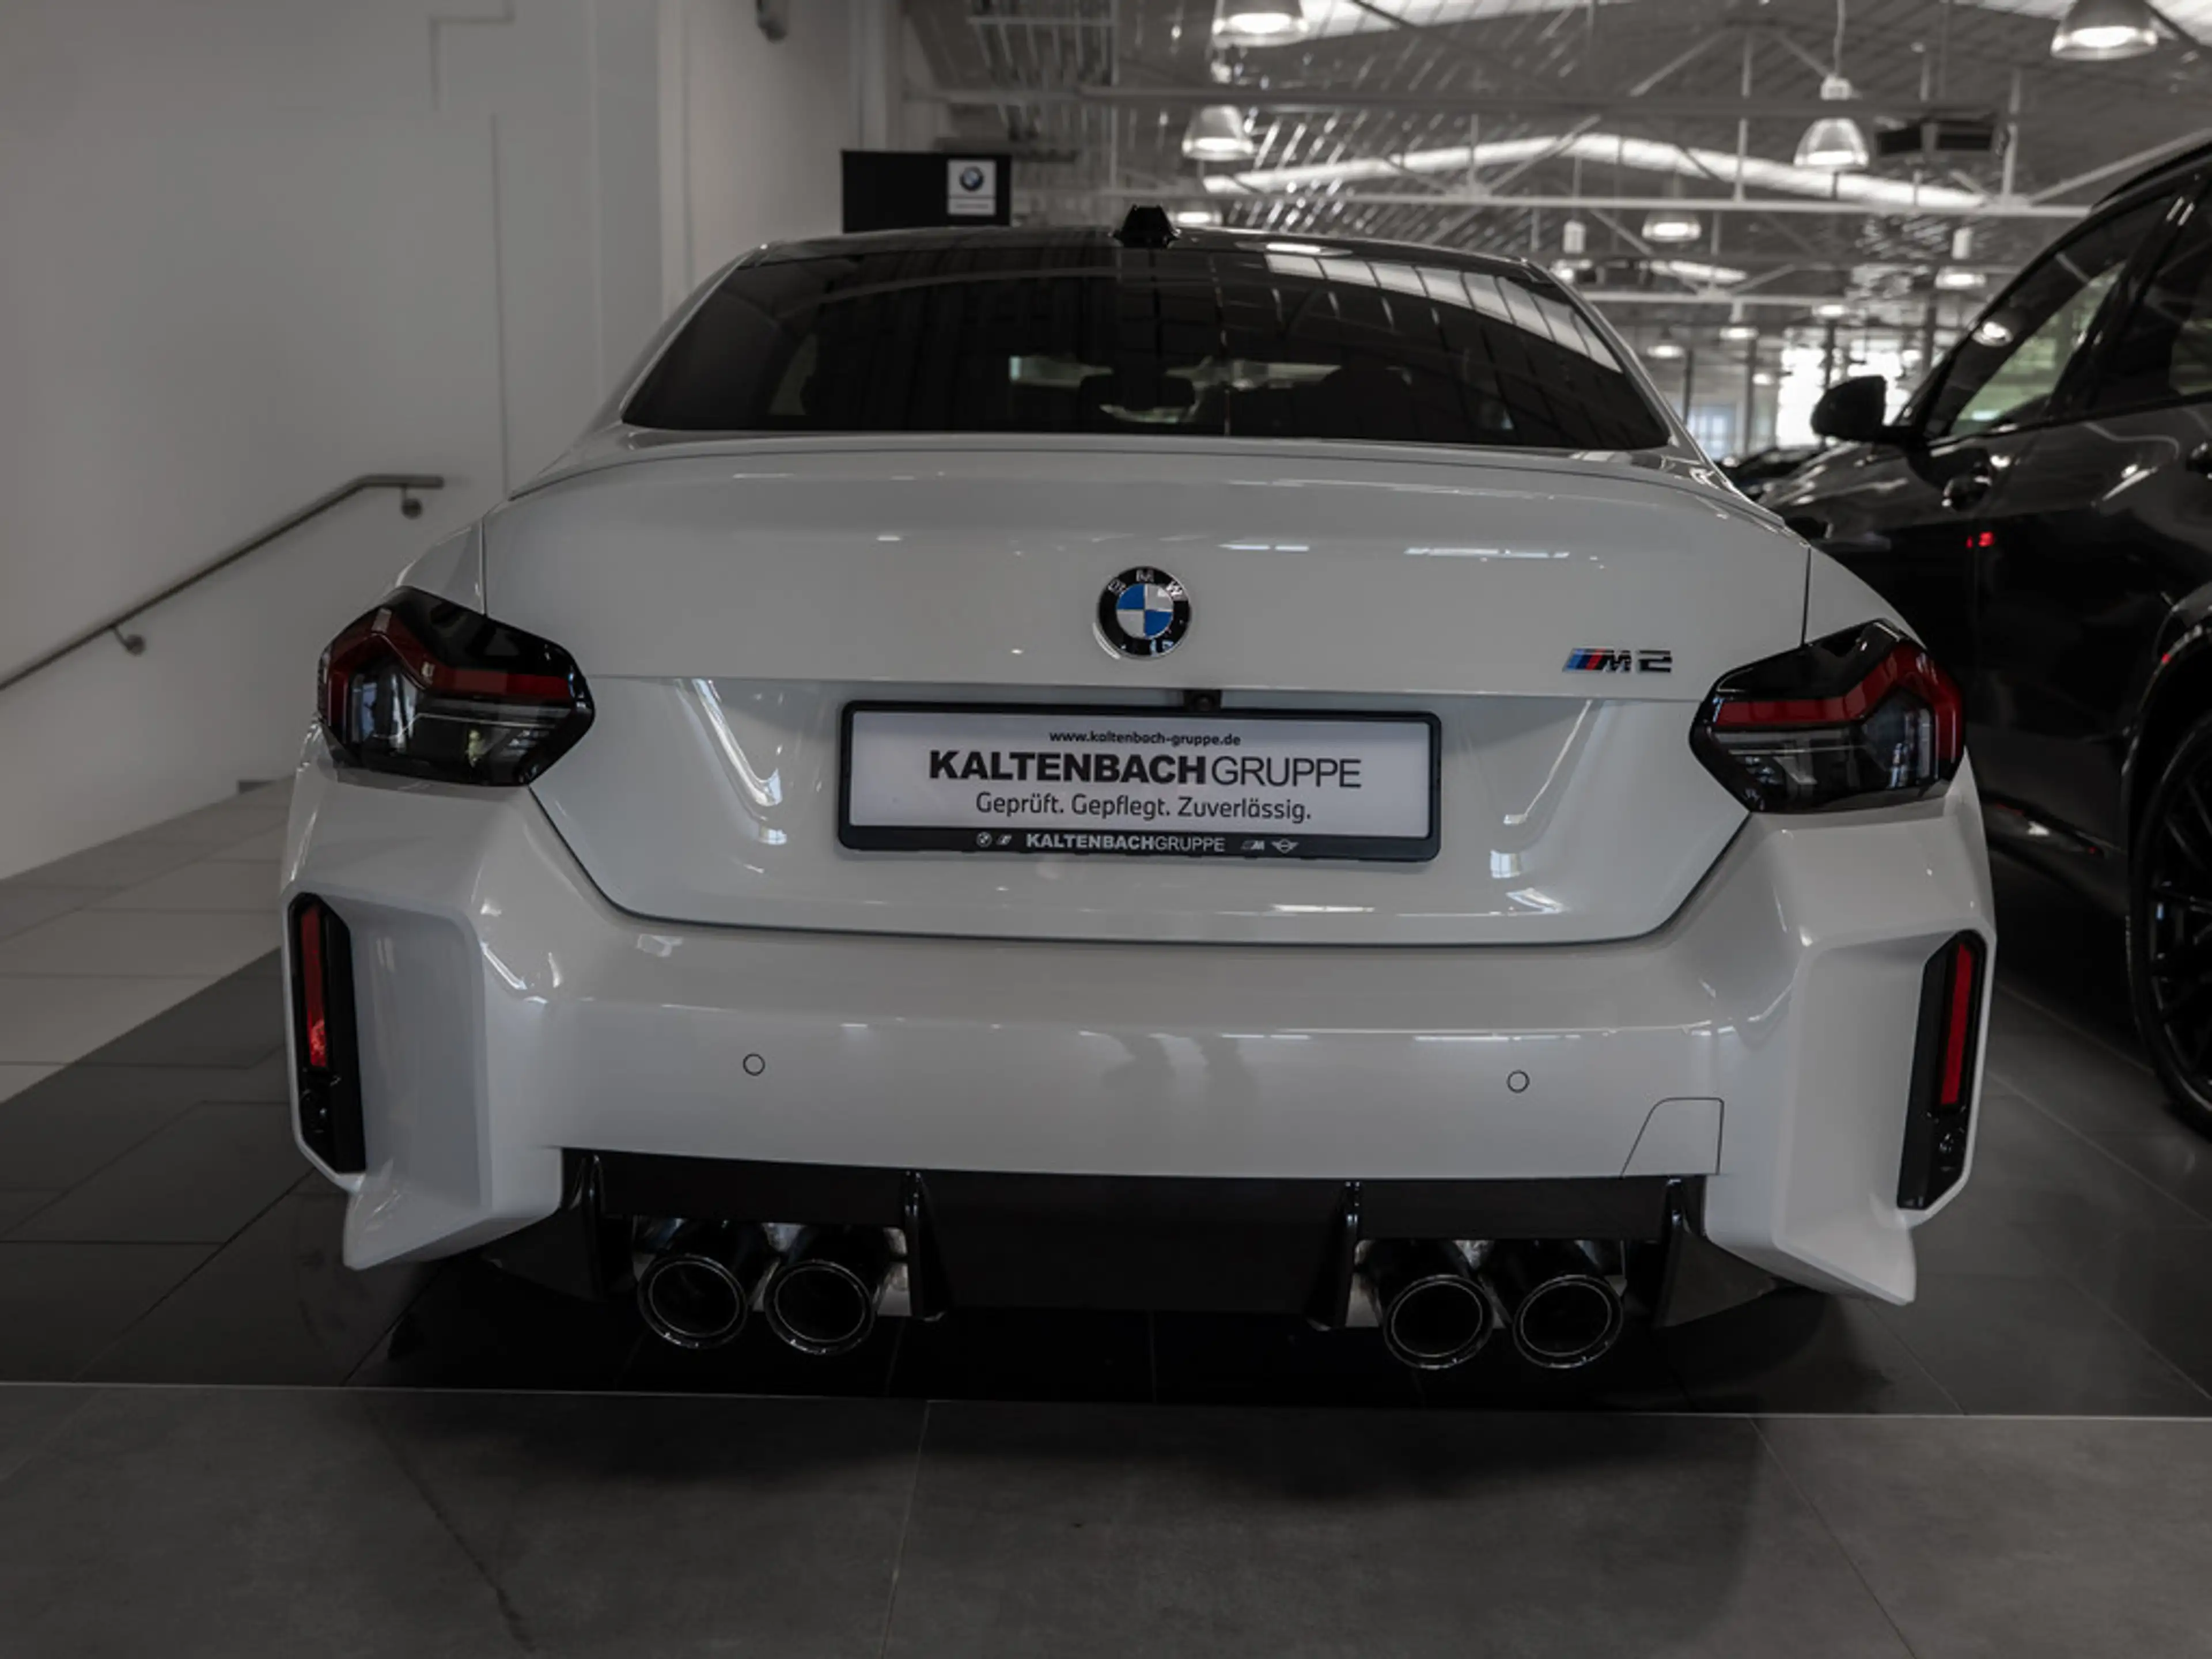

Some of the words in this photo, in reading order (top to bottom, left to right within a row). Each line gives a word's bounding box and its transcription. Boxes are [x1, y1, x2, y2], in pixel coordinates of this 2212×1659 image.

[1598, 649, 1673, 672] M2
[1049, 730, 1241, 746] www.kaltenbach-gruppe.de
[976, 791, 1065, 817] Geprüft.
[1071, 793, 1171, 821] Gepflegt.
[1177, 796, 1312, 824] Zuverlässig.
